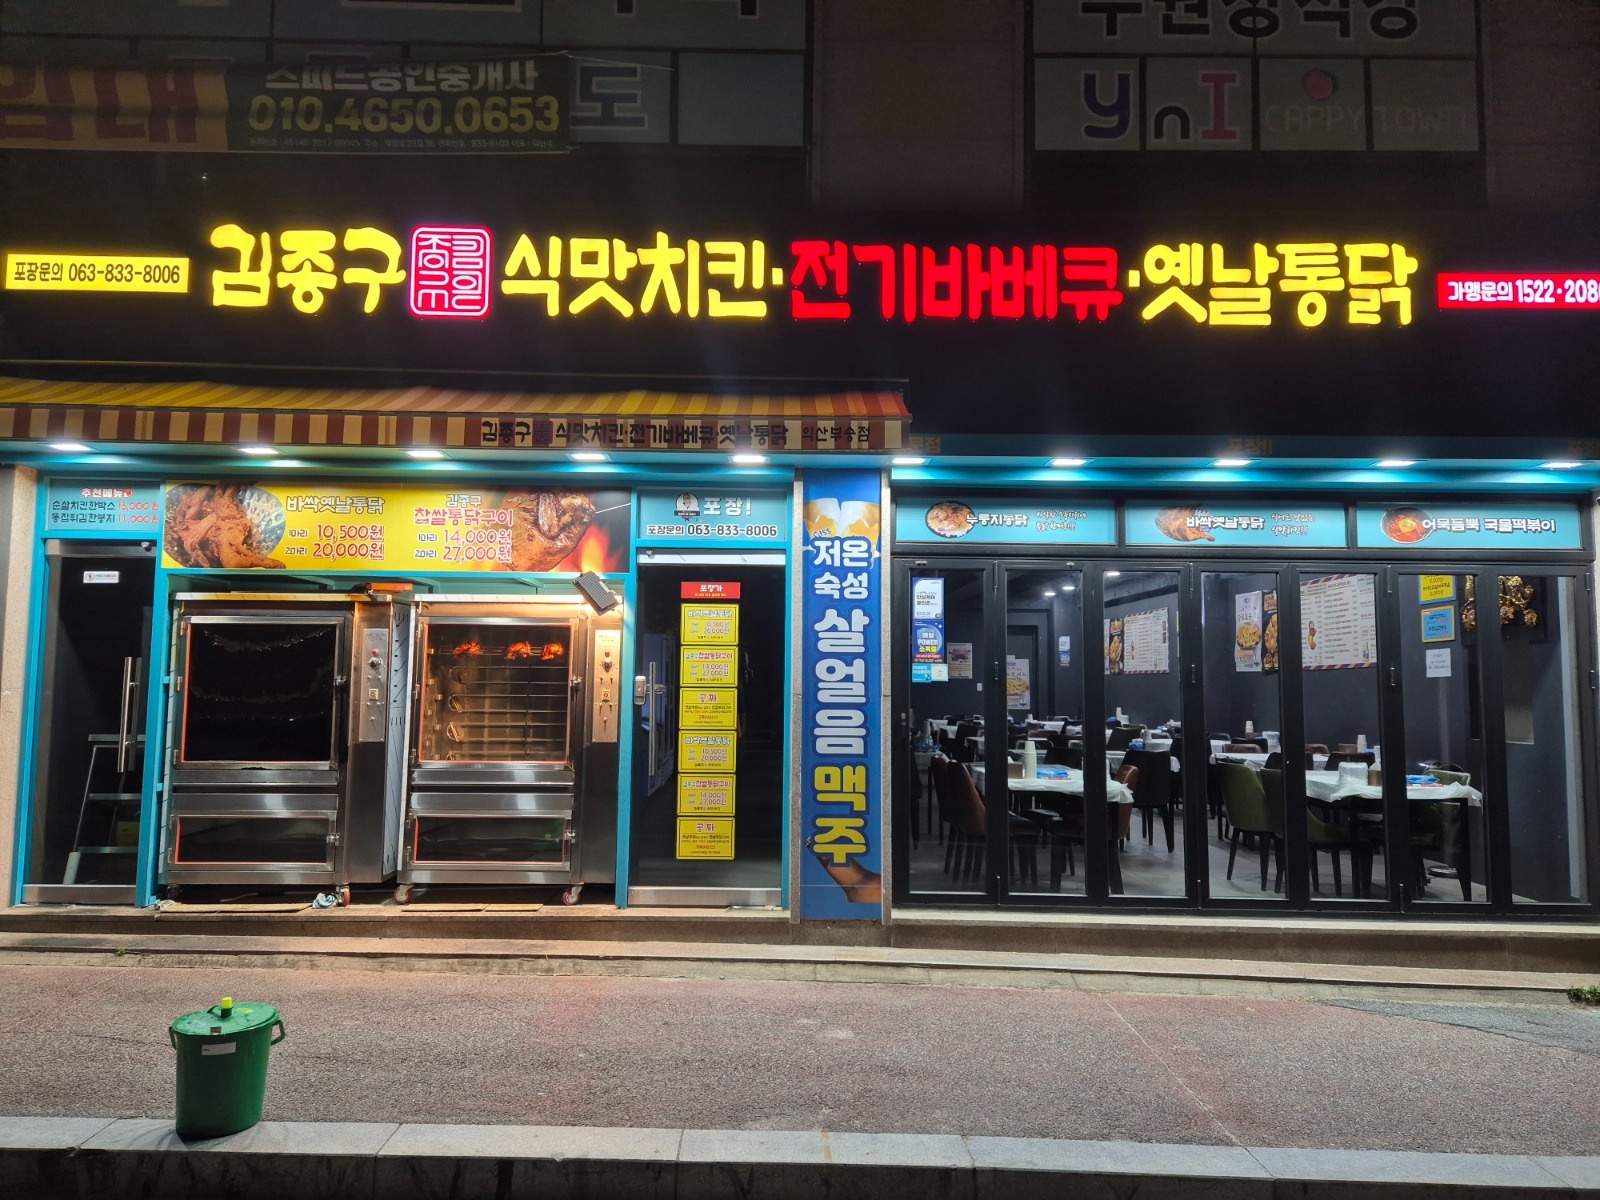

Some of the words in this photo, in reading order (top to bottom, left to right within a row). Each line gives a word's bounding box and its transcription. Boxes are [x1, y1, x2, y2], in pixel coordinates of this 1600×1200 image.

[265, 60, 539, 93] 스피드공인중개사
[248, 94, 560, 134] 010.4650.0653
[14, 262, 63, 282] 포장문의
[69, 263, 180, 283] 063-833-8006
[210, 223, 406, 314] 김종구
[1447, 281, 1513, 302] 가맹문의
[482, 421, 531, 443] 김종구
[81, 488, 122, 498] 추천메뉴
[446, 494, 482, 507] 김종구
[286, 495, 386, 514] 바싹옛날통닭
[414, 507, 513, 526] 찹쌀통닭구이
[1186, 515, 1265, 530] 바싹옛날통닭
[1483, 518, 1557, 533] 국물떡볶이
[317, 525, 385, 543] 10,500원
[443, 529, 512, 546] 14,000원
[647, 525, 684, 535] 포장문의
[686, 524, 778, 537] 063-833-8006
[312, 543, 385, 560] 20,000원
[442, 545, 512, 563] 27,000원
[813, 540, 869, 567] 저온
[813, 571, 869, 599] 숙성
